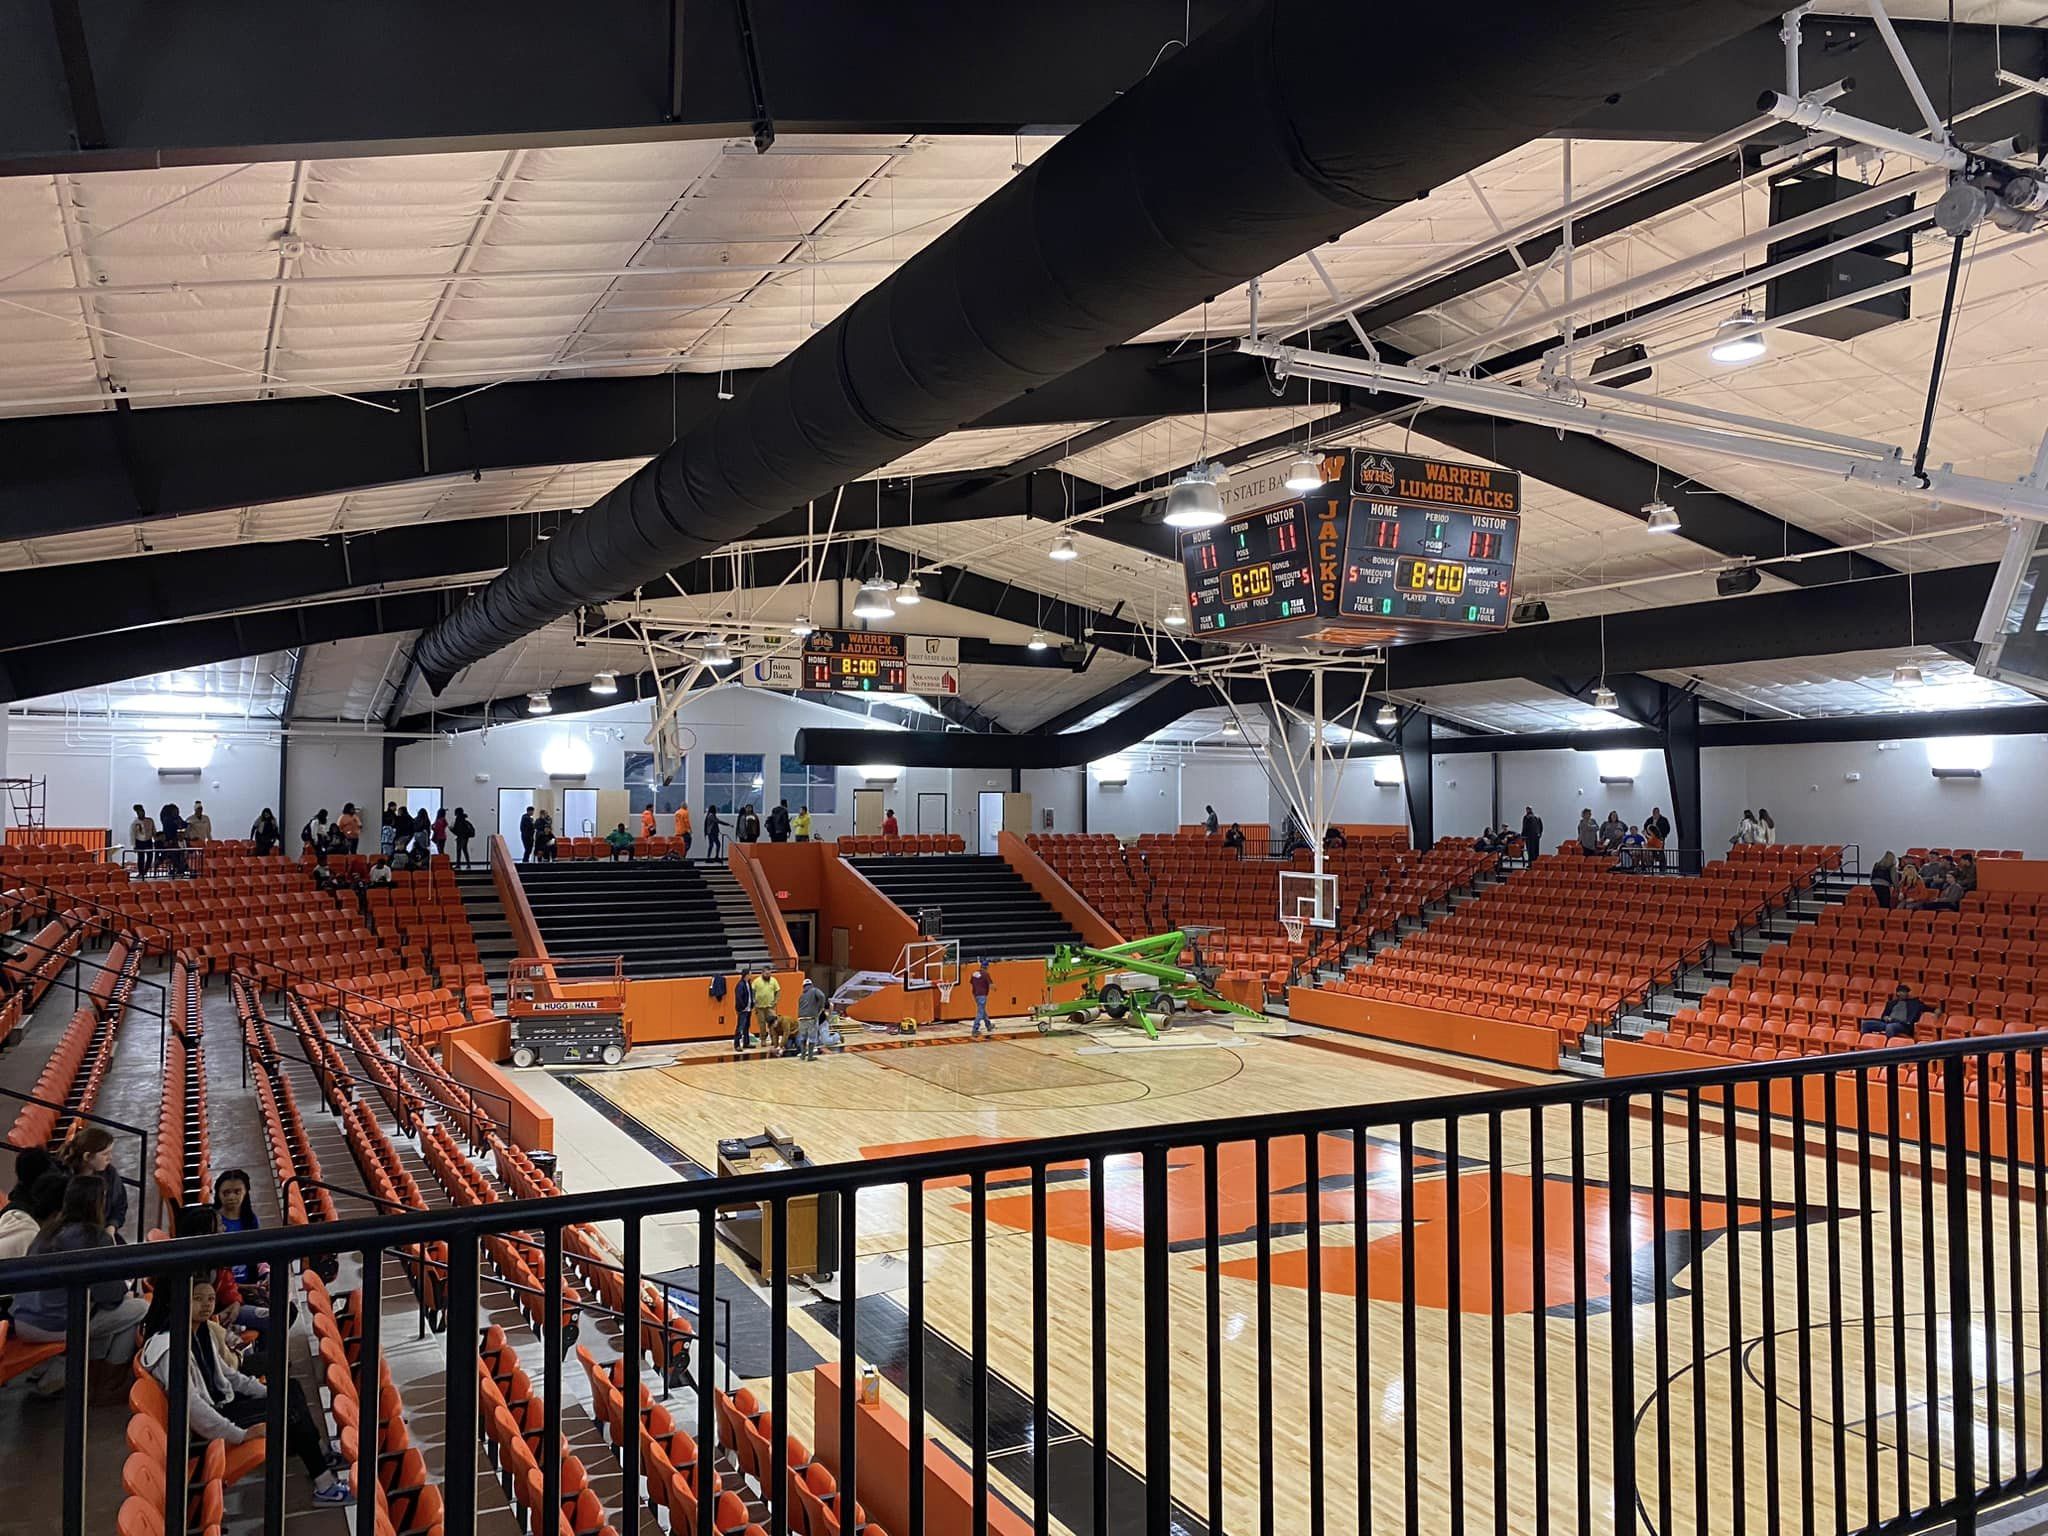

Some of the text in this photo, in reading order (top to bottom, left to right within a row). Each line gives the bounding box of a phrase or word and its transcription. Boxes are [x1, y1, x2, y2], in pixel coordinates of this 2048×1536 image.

[1362, 470, 1393, 486] WHS
[1425, 463, 1490, 488] WARREN
[1232, 483, 1265, 504] STATE
[1400, 480, 1514, 509] LUMBERJACKS
[1265, 508, 1294, 525] VISITOR
[1371, 503, 1398, 518] HOME
[1425, 512, 1449, 523] PERIOD
[1472, 515, 1507, 530] VISITOR
[1231, 523, 1249, 534] PERIOD
[1379, 521, 1399, 548] 11
[1435, 524, 1441, 539] 1
[1193, 530, 1211, 543] HOME
[1279, 523, 1296, 551] 11
[1318, 500, 1338, 601] JACKS
[1425, 541, 1443, 549] POSS
[1470, 532, 1490, 557] 11
[1201, 544, 1217, 569] 11
[1236, 548, 1249, 557] POSS
[1272, 560, 1289, 570] BONUS
[1372, 556, 1394, 566] BONUS
[1275, 571, 1300, 582] TIMEOUTS
[1302, 568, 1310, 584] 5
[1349, 566, 1358, 582] 5
[1360, 568, 1391, 578] TIMEOUTS
[1467, 566, 1488, 575] BONUS
[1204, 576, 1219, 586] BONUS
[1232, 567, 1271, 598] 8:00
[1367, 577, 1383, 585] LEFT
[1412, 562, 1463, 592] 8:00
[1282, 580, 1295, 588] LEFT
[1467, 579, 1498, 589] TIMEOUTS
[1498, 581, 1508, 596] 5
[1198, 588, 1219, 599] TIMEOUTS
[1475, 587, 1489, 595] LEFT
[1191, 592, 1198, 606] 5
[1204, 596, 1215, 604] LEFT
[1230, 598, 1269, 611] PLAYER FOULS
[1290, 598, 1304, 607] TEAM
[1356, 596, 1373, 604] TEAM
[1403, 593, 1455, 605] PLAYER FOULS
[1282, 601, 1289, 616] 0
[1290, 606, 1306, 615] FOULS
[1354, 604, 1373, 612] FOULS
[1383, 599, 1391, 614] 0
[1479, 607, 1494, 615] TEAM
[1200, 615, 1212, 624] TEAM
[1468, 606, 1476, 621] 0
[1477, 614, 1495, 622] FOULS
[1218, 613, 1225, 628] 0
[849, 633, 891, 645] WARREN
[841, 643, 898, 655] LADYJACKS
[808, 656, 827, 664] HOME
[842, 658, 876, 674] 8:00
[880, 660, 904, 668] VISITOR
[755, 660, 790, 681] Union
[773, 671, 793, 680] Bank
[815, 665, 828, 680] 11
[890, 669, 903, 684] 11
